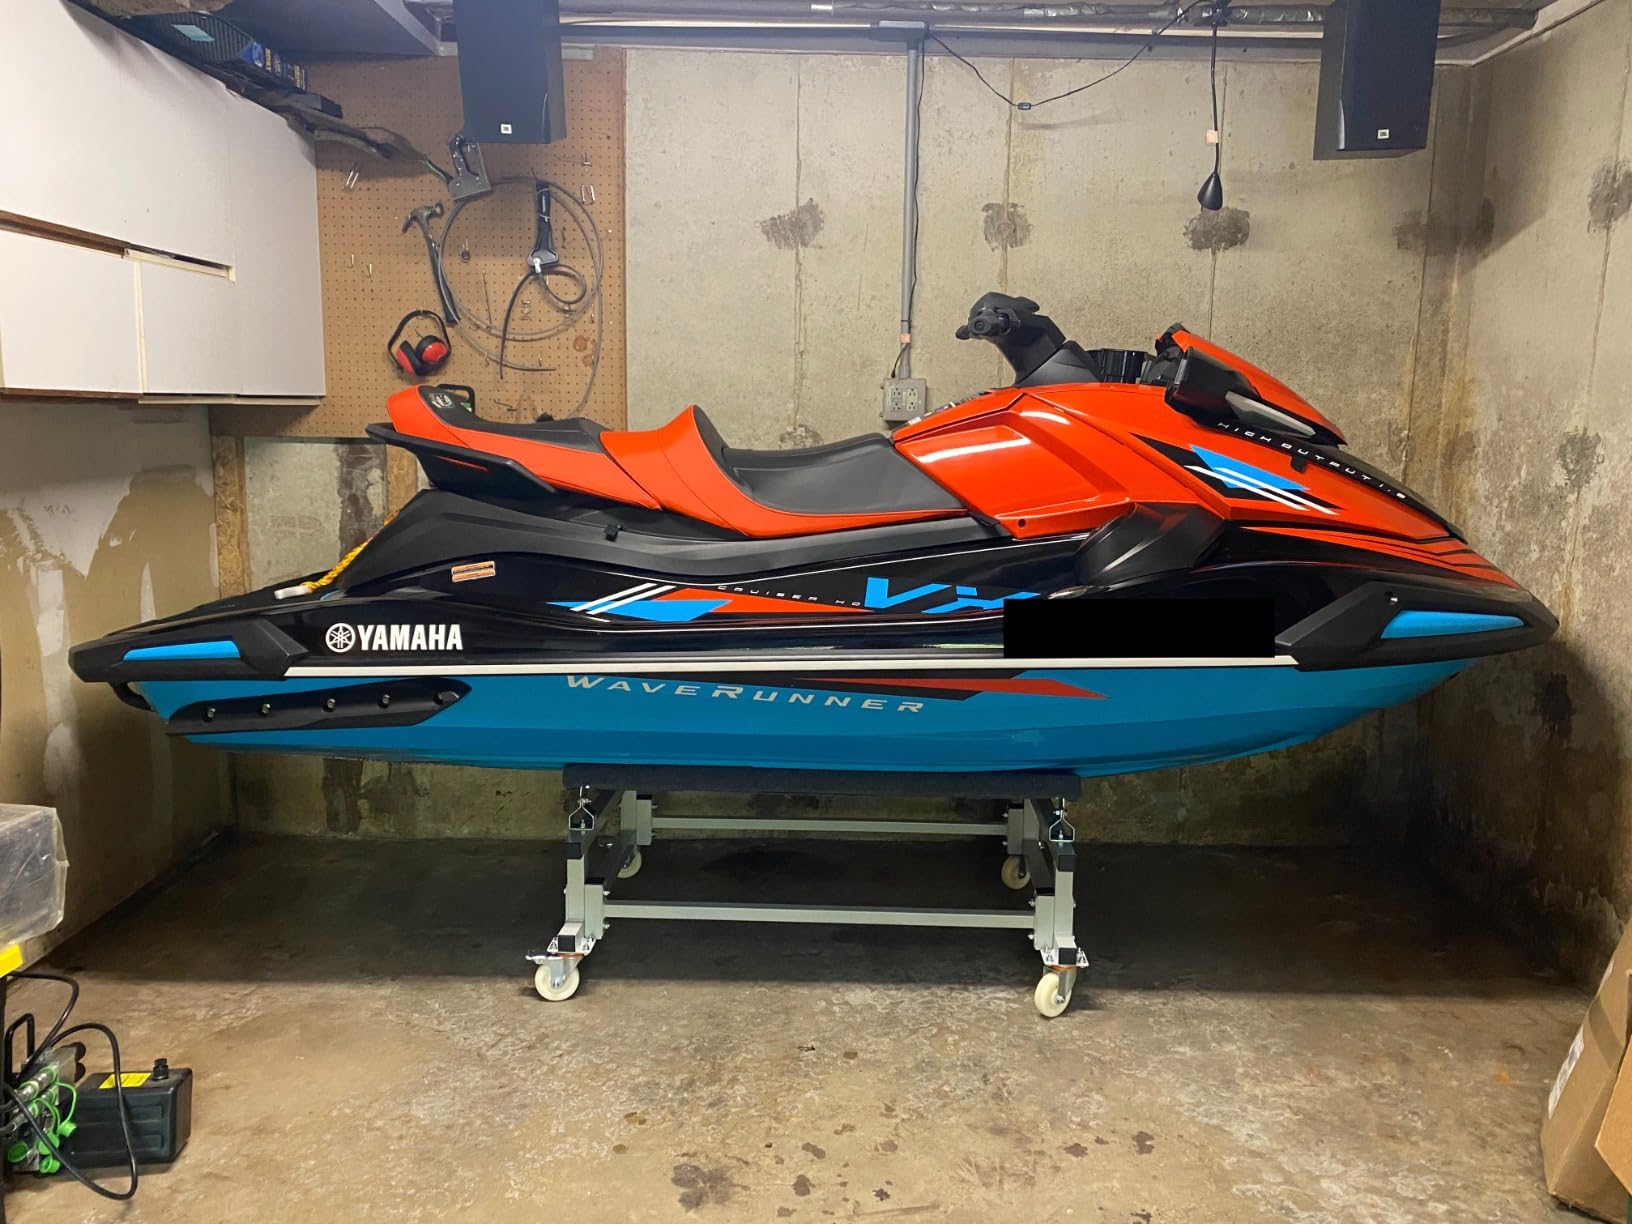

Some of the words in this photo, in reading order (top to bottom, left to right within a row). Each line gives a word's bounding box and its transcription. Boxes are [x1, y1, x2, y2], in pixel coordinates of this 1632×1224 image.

[1218, 422, 1272, 442] HIGH
[1281, 442, 1371, 481] OUTPUT
[717, 585, 818, 601] CRUISER
[835, 599, 861, 607] HO
[357, 624, 464, 651] YAMAHA
